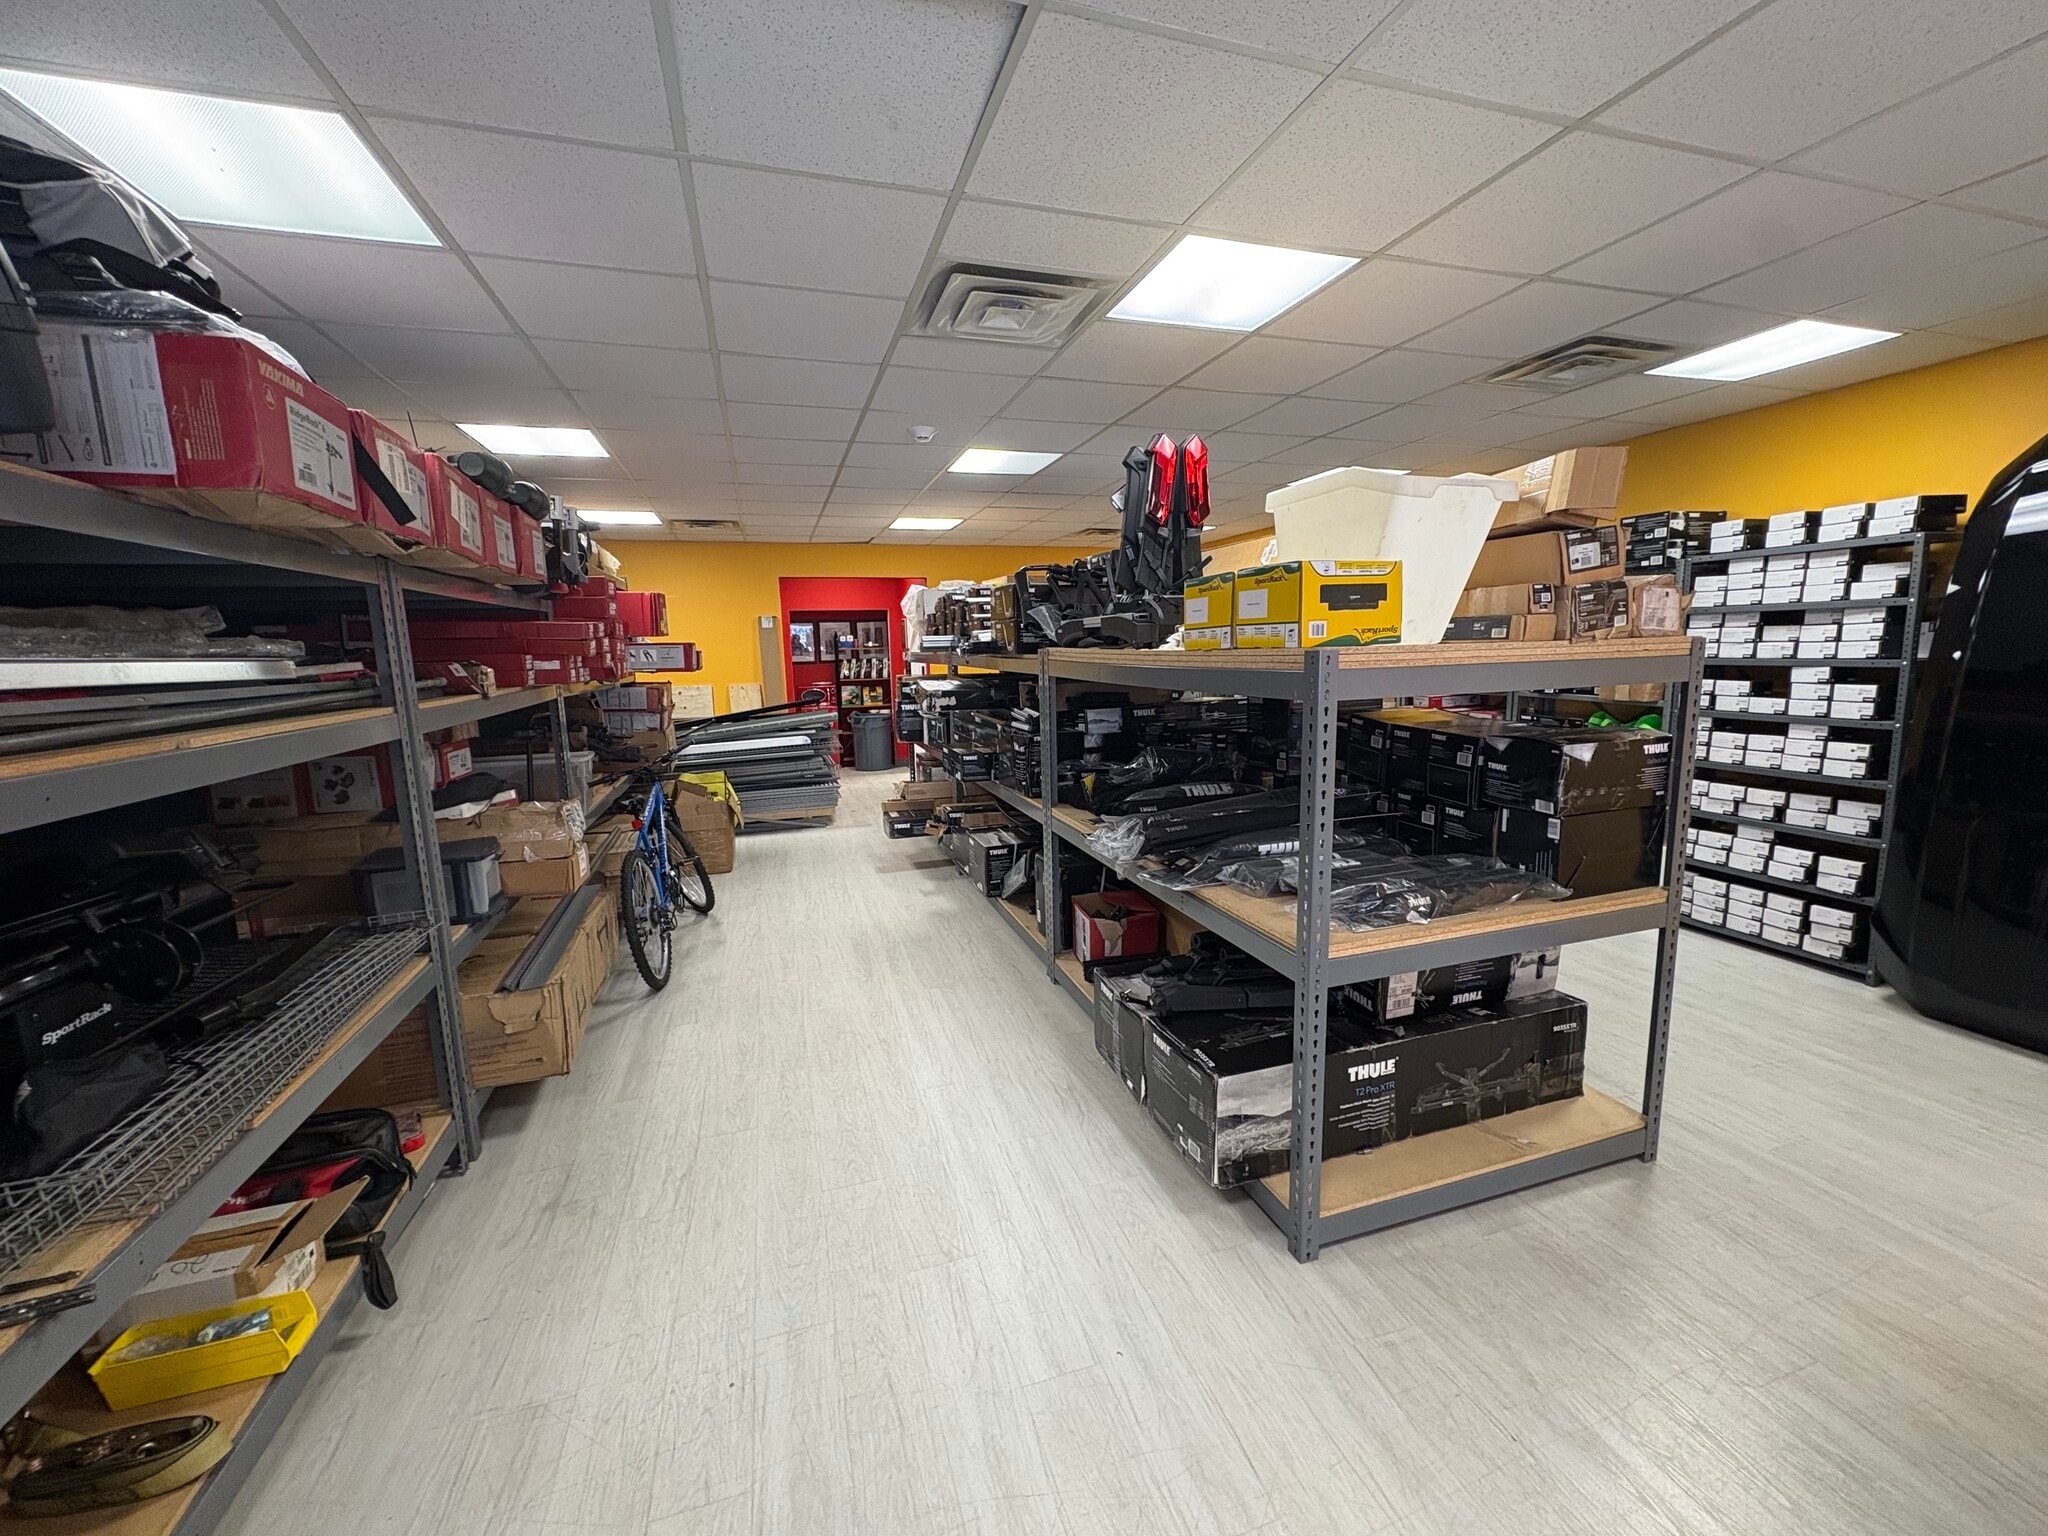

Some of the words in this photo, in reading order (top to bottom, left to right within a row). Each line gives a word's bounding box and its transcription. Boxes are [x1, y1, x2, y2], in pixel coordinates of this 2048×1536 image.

[257, 358, 304, 397] YAKIMA
[1254, 573, 1288, 587] SportRack
[1355, 625, 1398, 636] SportRack
[1133, 708, 1156, 717] THULE
[1643, 743, 1669, 755] THULE
[1180, 783, 1233, 797] THULE
[1446, 807, 1465, 817] THULE
[1165, 825, 1188, 833] THULE
[1452, 990, 1482, 1005] THULE
[41, 1003, 112, 1046] SportRack
[1153, 1033, 1172, 1056] THULE
[1348, 1059, 1396, 1082] THULE
[1355, 1087, 1366, 1096] T2
[1366, 1086, 1380, 1094] Pro
[1380, 1081, 1395, 1092] XTR
